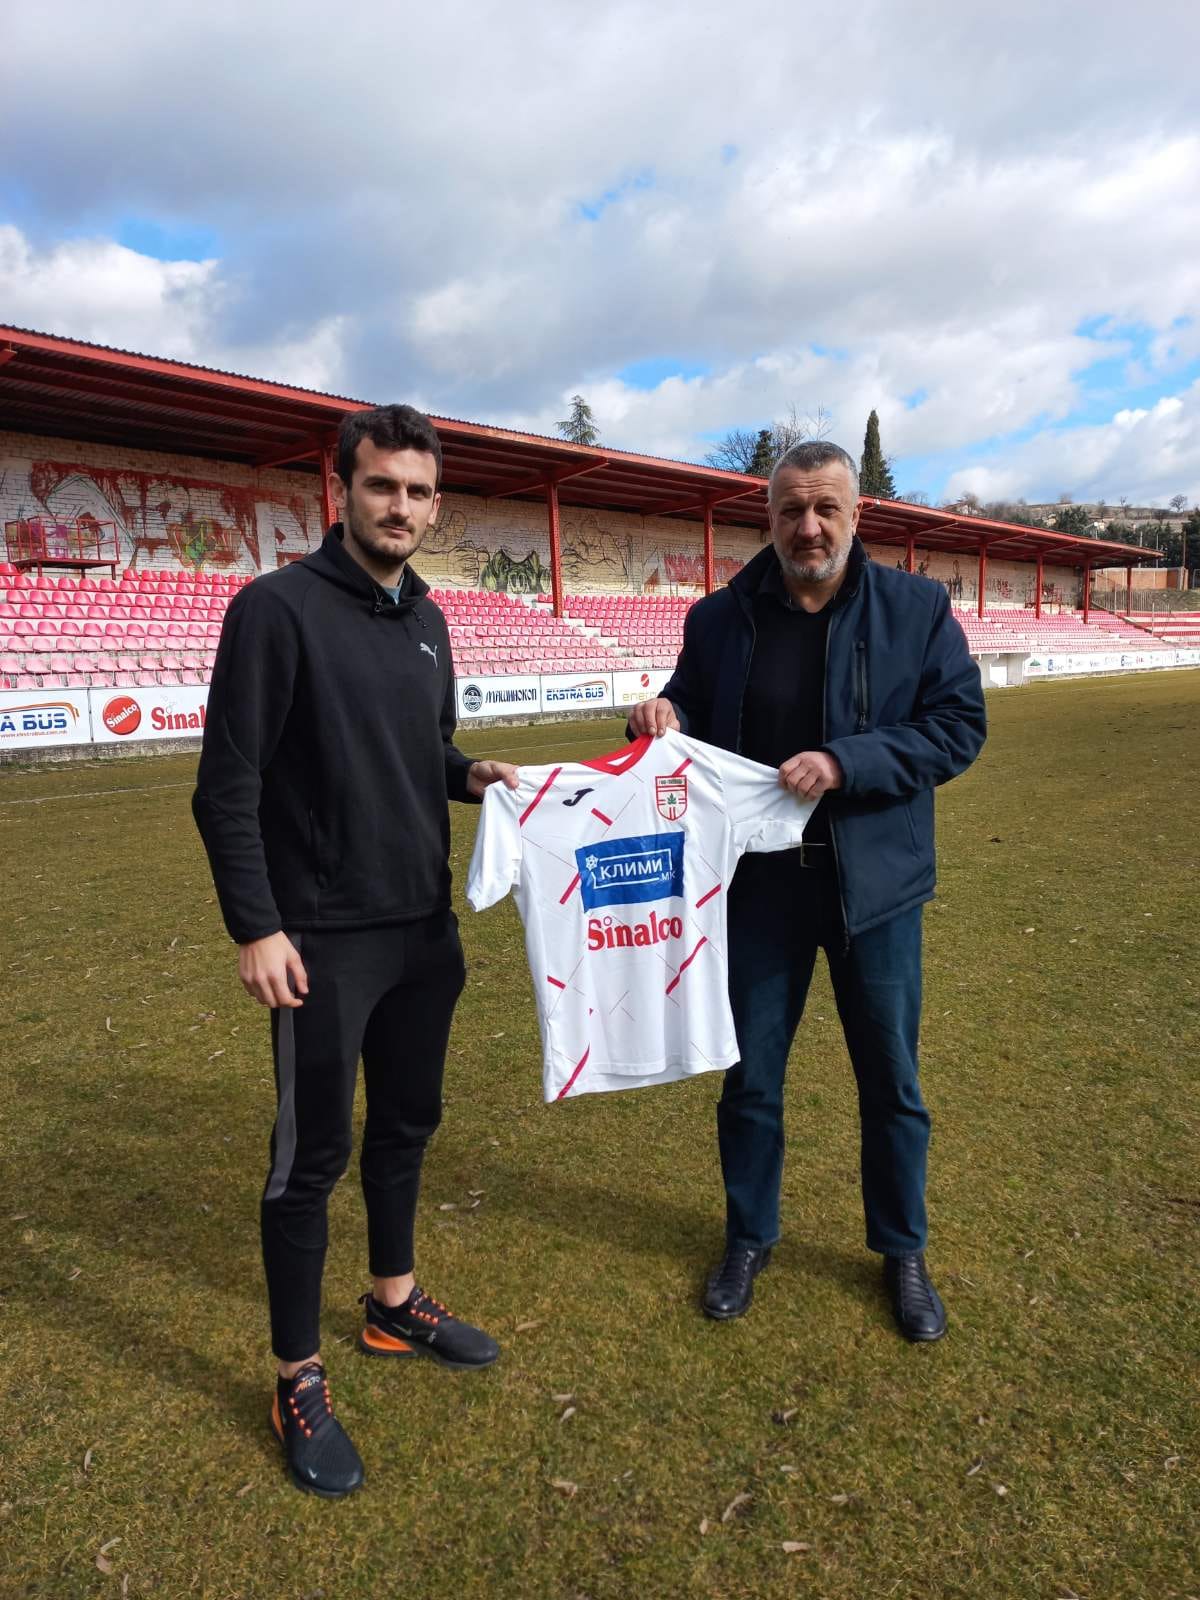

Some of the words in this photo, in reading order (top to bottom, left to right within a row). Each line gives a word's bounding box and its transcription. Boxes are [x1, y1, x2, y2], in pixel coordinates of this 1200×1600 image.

[546, 689, 583, 700] EKSTRA
[585, 687, 604, 698] BUS
[23, 713, 67, 730] BUS
[106, 703, 139, 728] Sinalco
[600, 858, 663, 880] КЛИМИ
[587, 911, 683, 951] Sinalco
